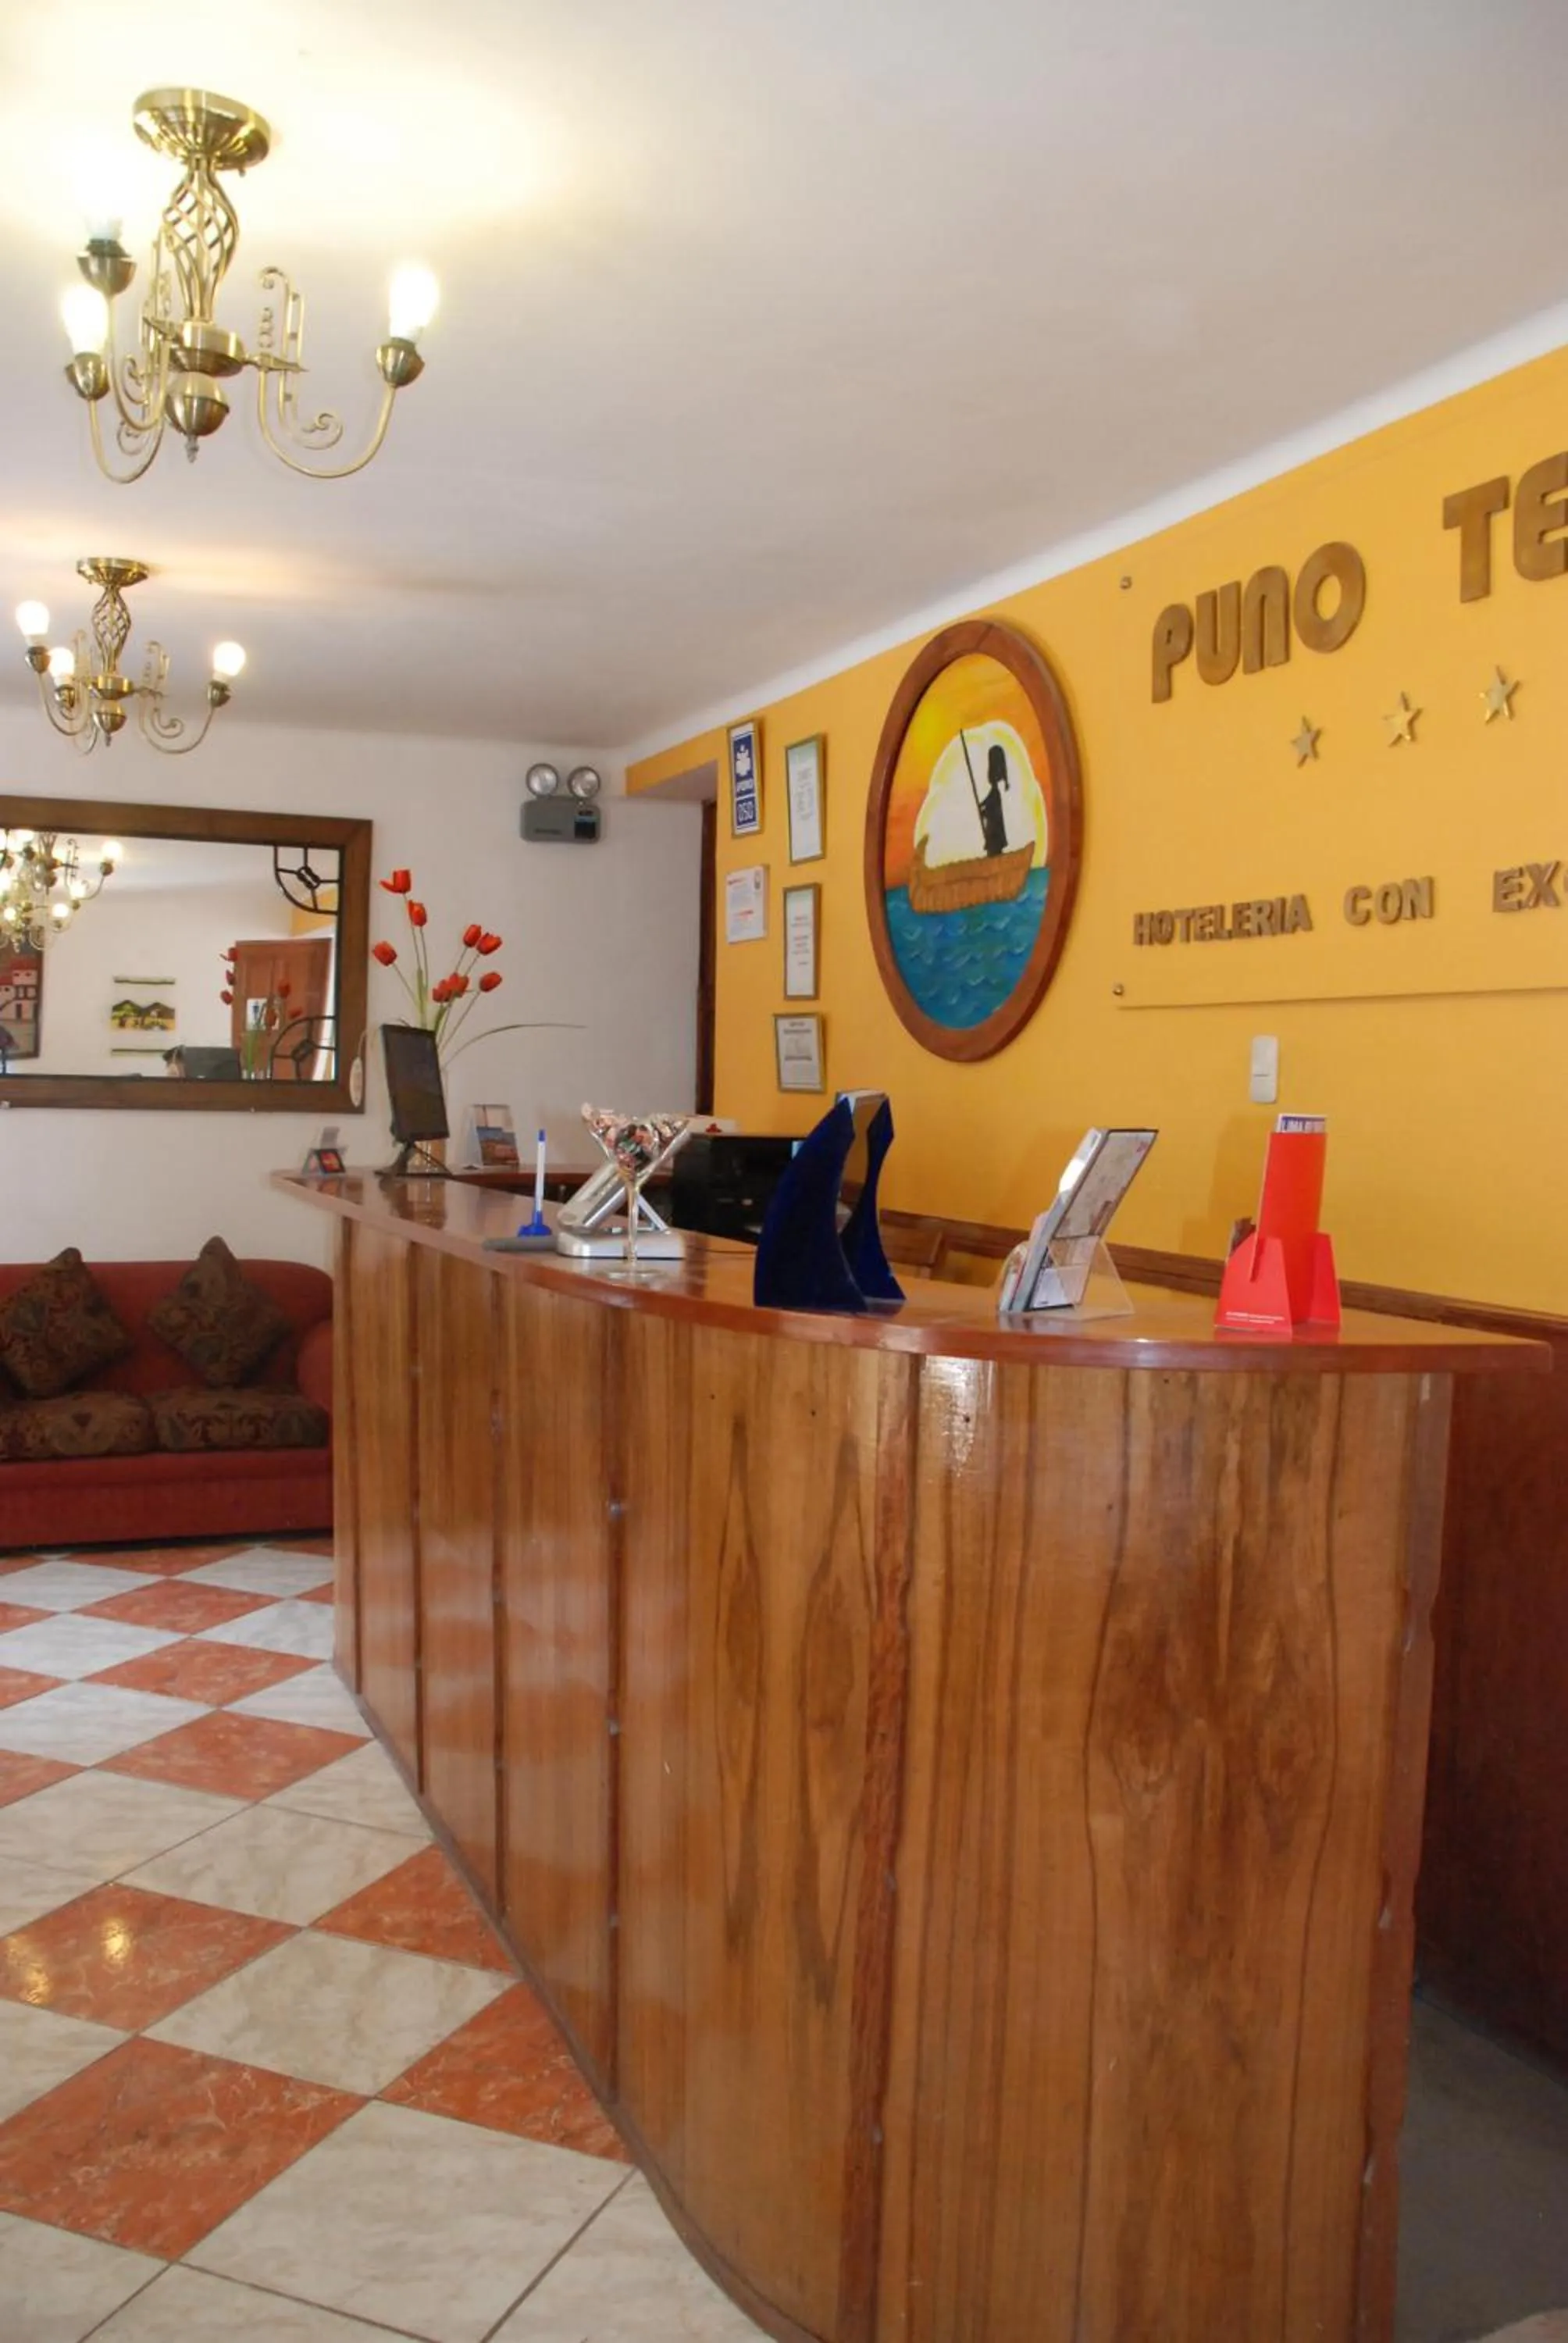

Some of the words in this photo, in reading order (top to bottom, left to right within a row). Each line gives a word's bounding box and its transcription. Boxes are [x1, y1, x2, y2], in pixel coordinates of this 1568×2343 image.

[1152, 541, 1367, 703] PUNO
[1133, 894, 1313, 946] HOTELERIA
[1343, 876, 1435, 925] CON
[1492, 860, 1568, 913] EX
